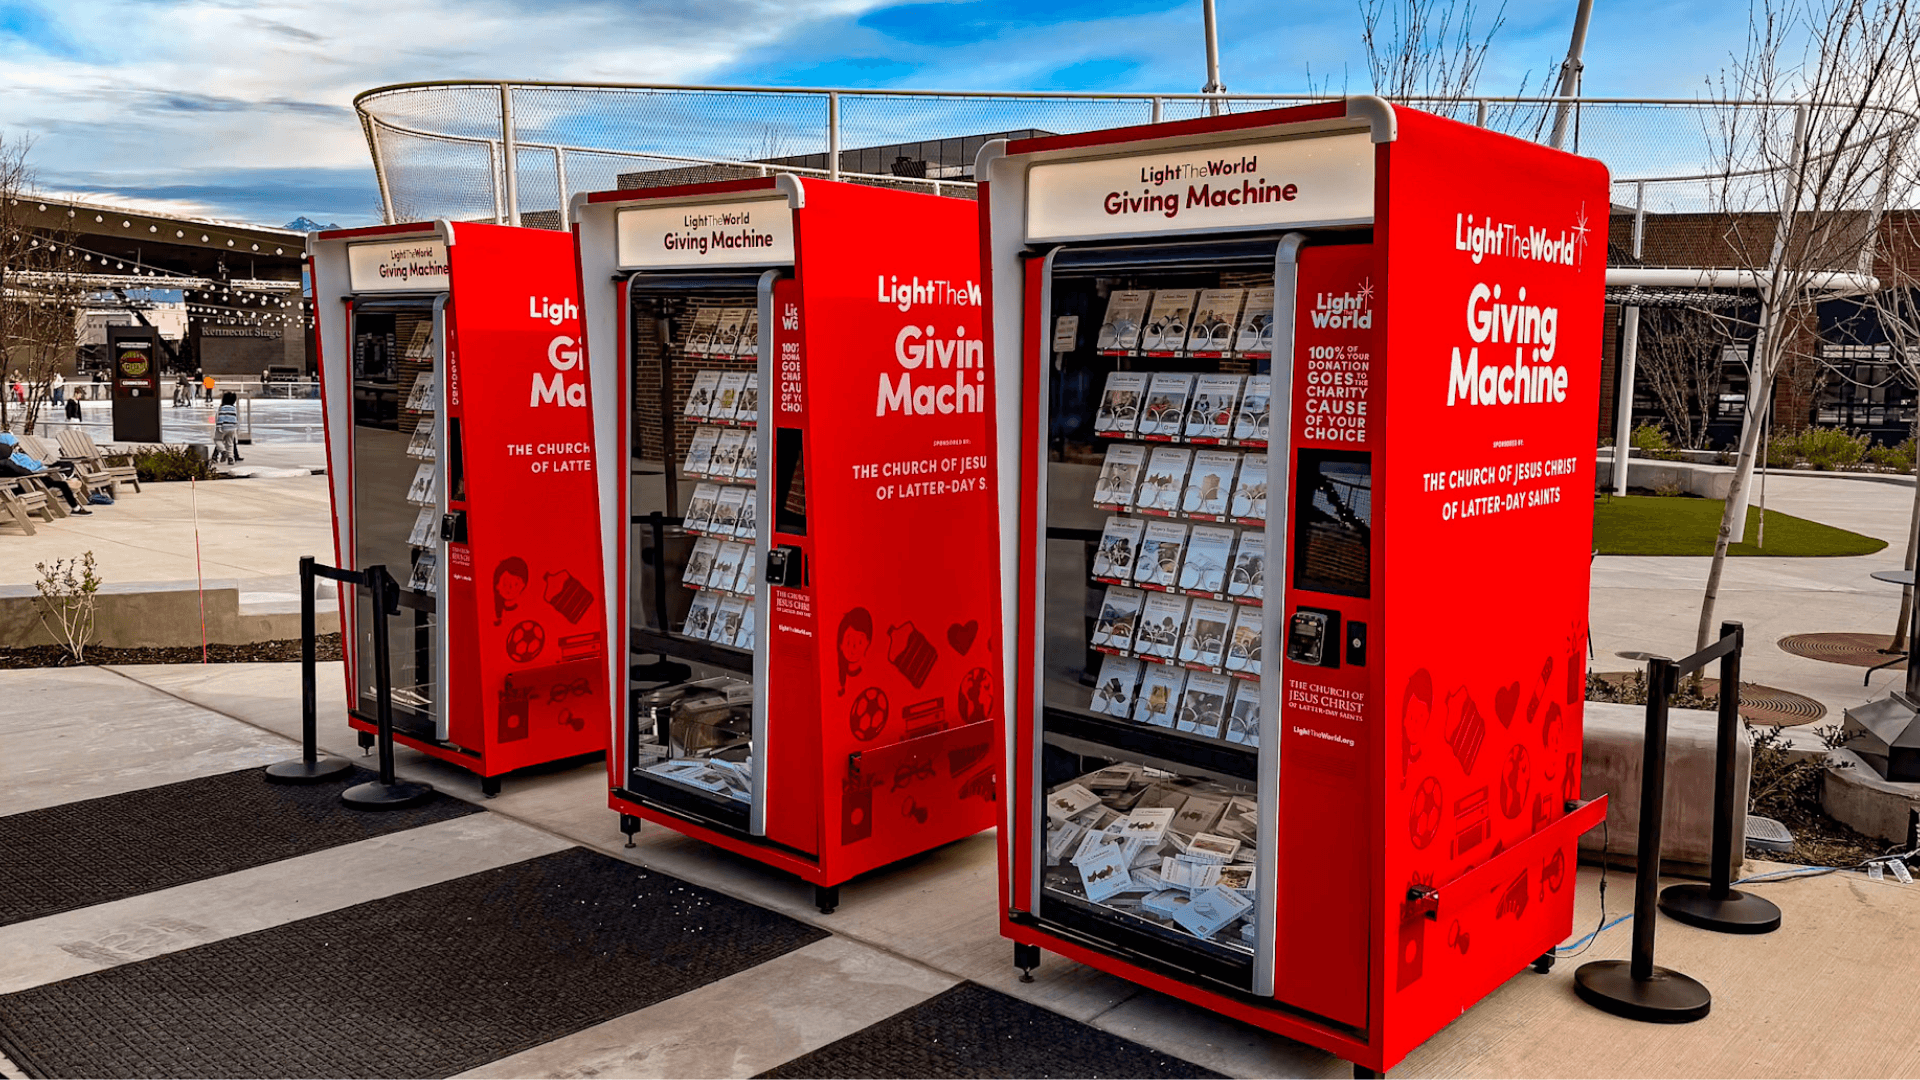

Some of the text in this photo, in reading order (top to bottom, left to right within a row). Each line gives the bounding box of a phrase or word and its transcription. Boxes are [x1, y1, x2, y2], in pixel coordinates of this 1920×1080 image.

[1141, 156, 1257, 186] LightTheWorld
[1104, 178, 1298, 218] Giving Machine
[684, 212, 750, 230] LightTheWorld
[664, 229, 773, 254] Giving Machine
[1455, 212, 1575, 265] LightTheWorld
[379, 260, 449, 281] Giving Machine
[530, 296, 578, 326] Ligh
[1316, 292, 1364, 314] Light
[1310, 309, 1373, 329] World
[1466, 282, 1558, 363] Giving
[202, 327, 282, 340] Kennecott Stage
[895, 325, 984, 370] Givin
[1308, 346, 1346, 360] 100%
[1347, 353, 1370, 361] YOUR
[1308, 360, 1370, 372] DONATION
[1447, 347, 1568, 406] Machine
[1307, 371, 1354, 386] GOES
[1354, 379, 1369, 387] THE
[530, 373, 587, 407] Ma
[781, 393, 792, 402] OF
[876, 370, 985, 417] Machi
[1306, 386, 1369, 399] CHARITY
[1305, 399, 1367, 416] CAUSE
[1305, 415, 1366, 429] OF YOUR
[1304, 427, 1366, 443] CHOICE
[507, 442, 591, 456] THE CHURCH
[531, 460, 591, 474] OF LATTE
[852, 455, 987, 480] THE CHURCH OF JESU
[1423, 457, 1577, 492] THE CHURCH OF JESUS CHRIST
[876, 476, 988, 500] OF LATTER-DAY S
[1442, 486, 1561, 521] OF LATTER-DAY SAINTS
[1289, 679, 1365, 701] THE CHURCH OF
[1289, 690, 1364, 713] JESUS CHRIST
[1299, 703, 1339, 717] LATTER-DAY
[1339, 711, 1363, 722] SAINTS
